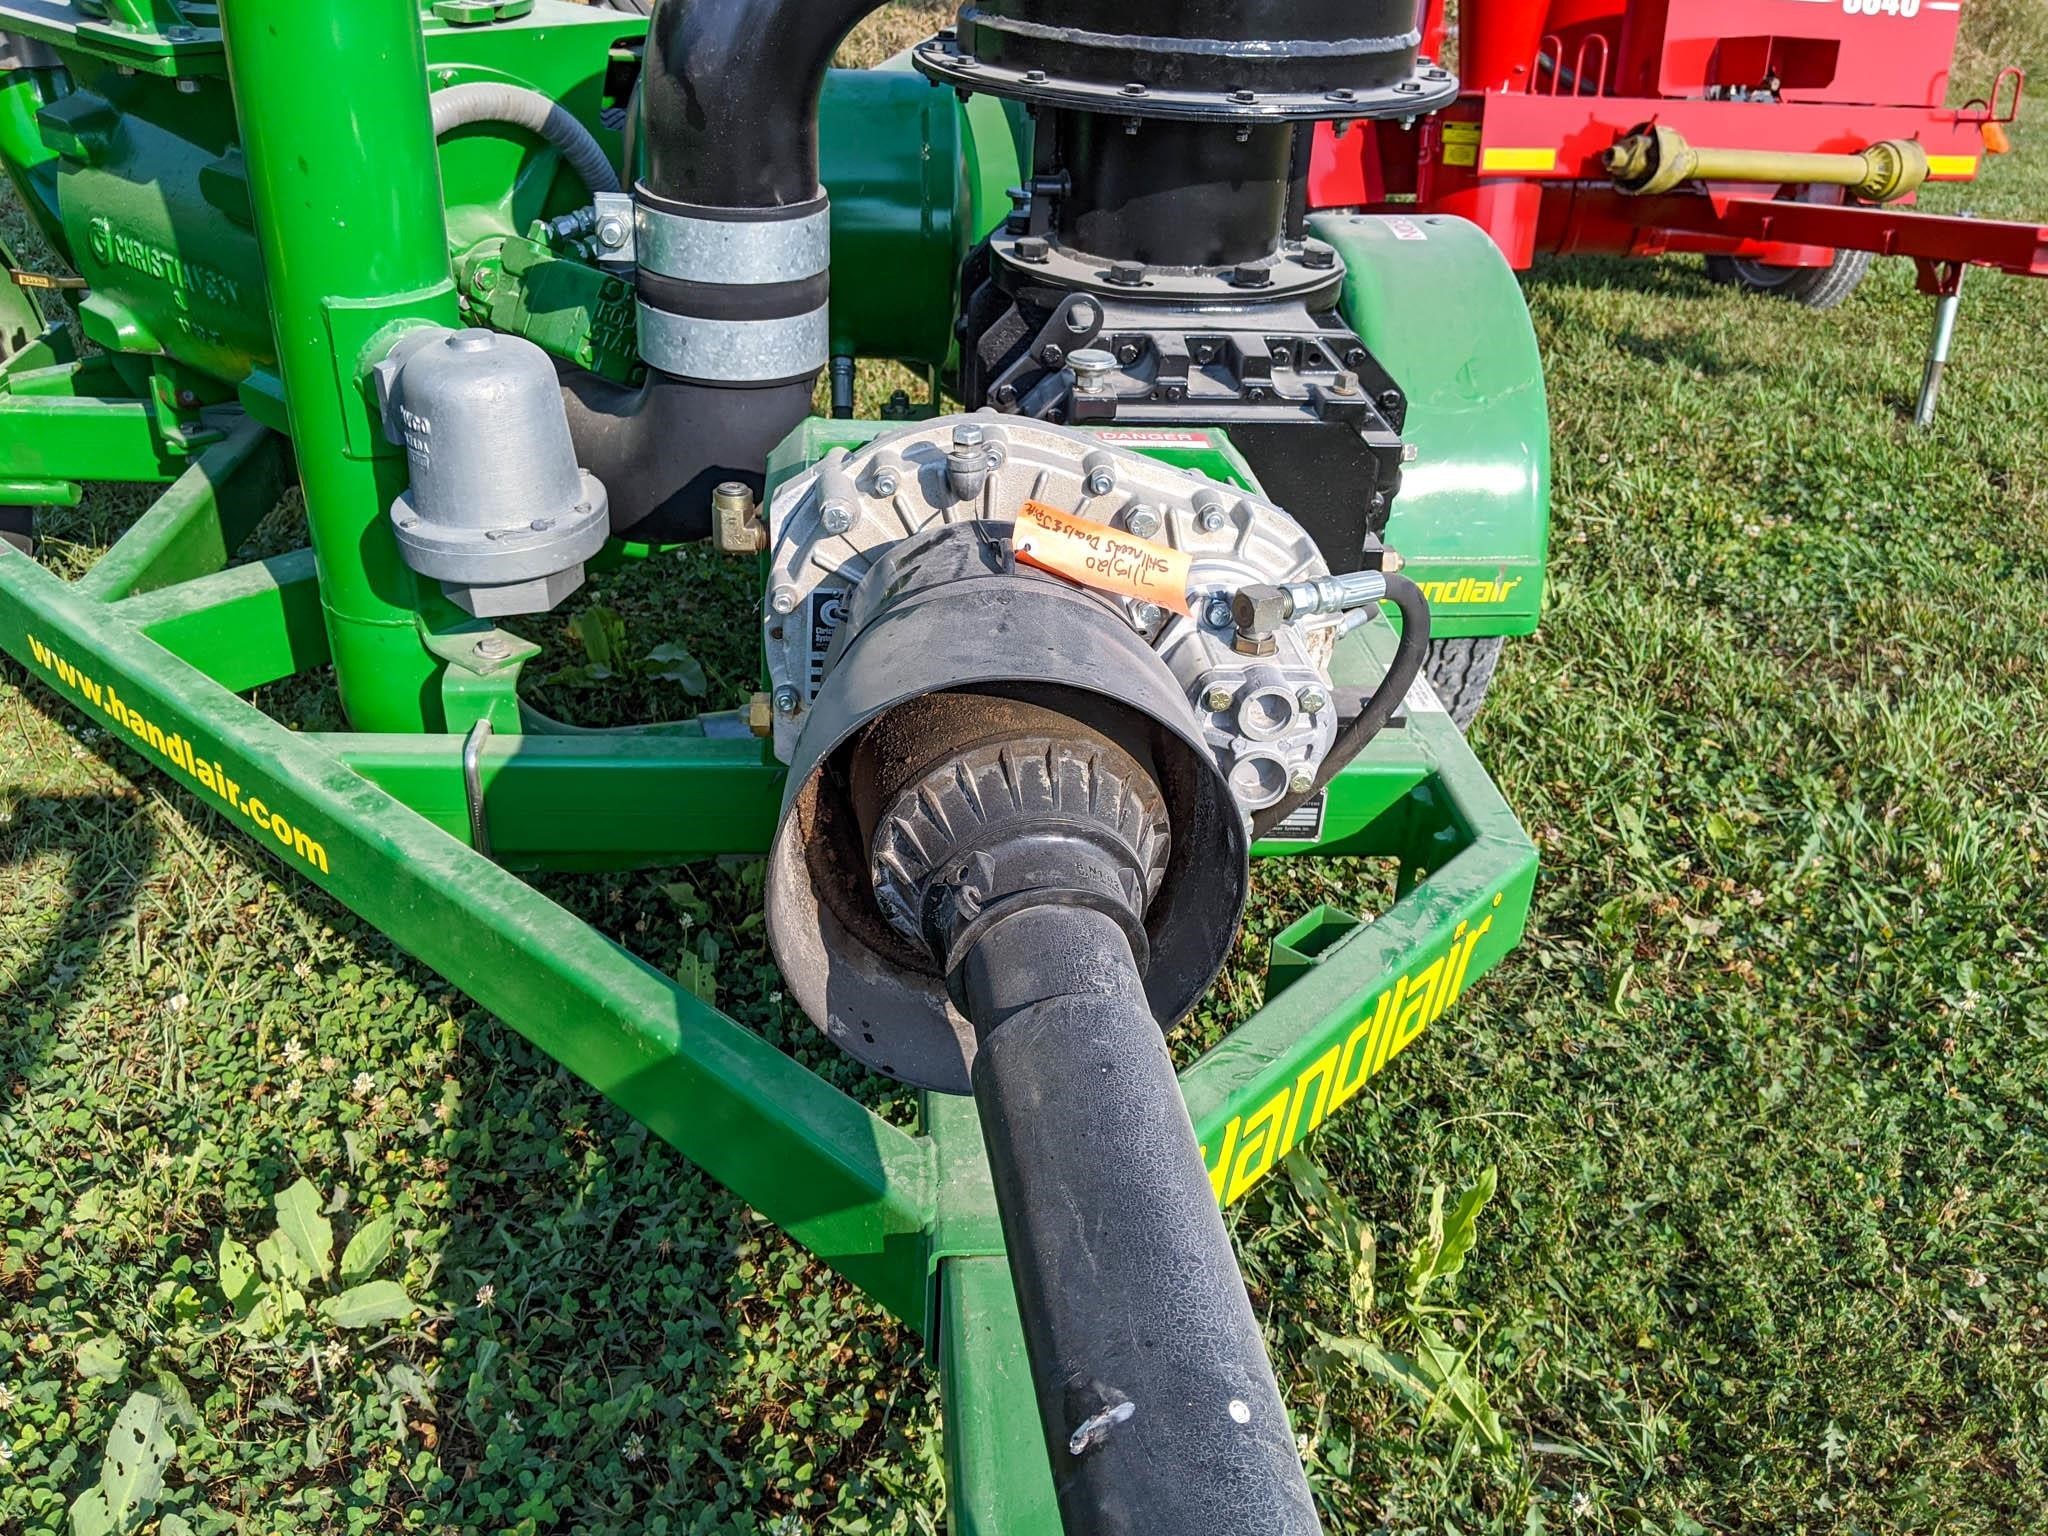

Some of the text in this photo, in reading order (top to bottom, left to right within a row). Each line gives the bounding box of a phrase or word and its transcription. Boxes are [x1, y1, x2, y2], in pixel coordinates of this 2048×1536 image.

[1101, 432, 1193, 441] DANGER
[1416, 577, 1522, 603] ndlair
[27, 634, 329, 874] www.handlair.com
